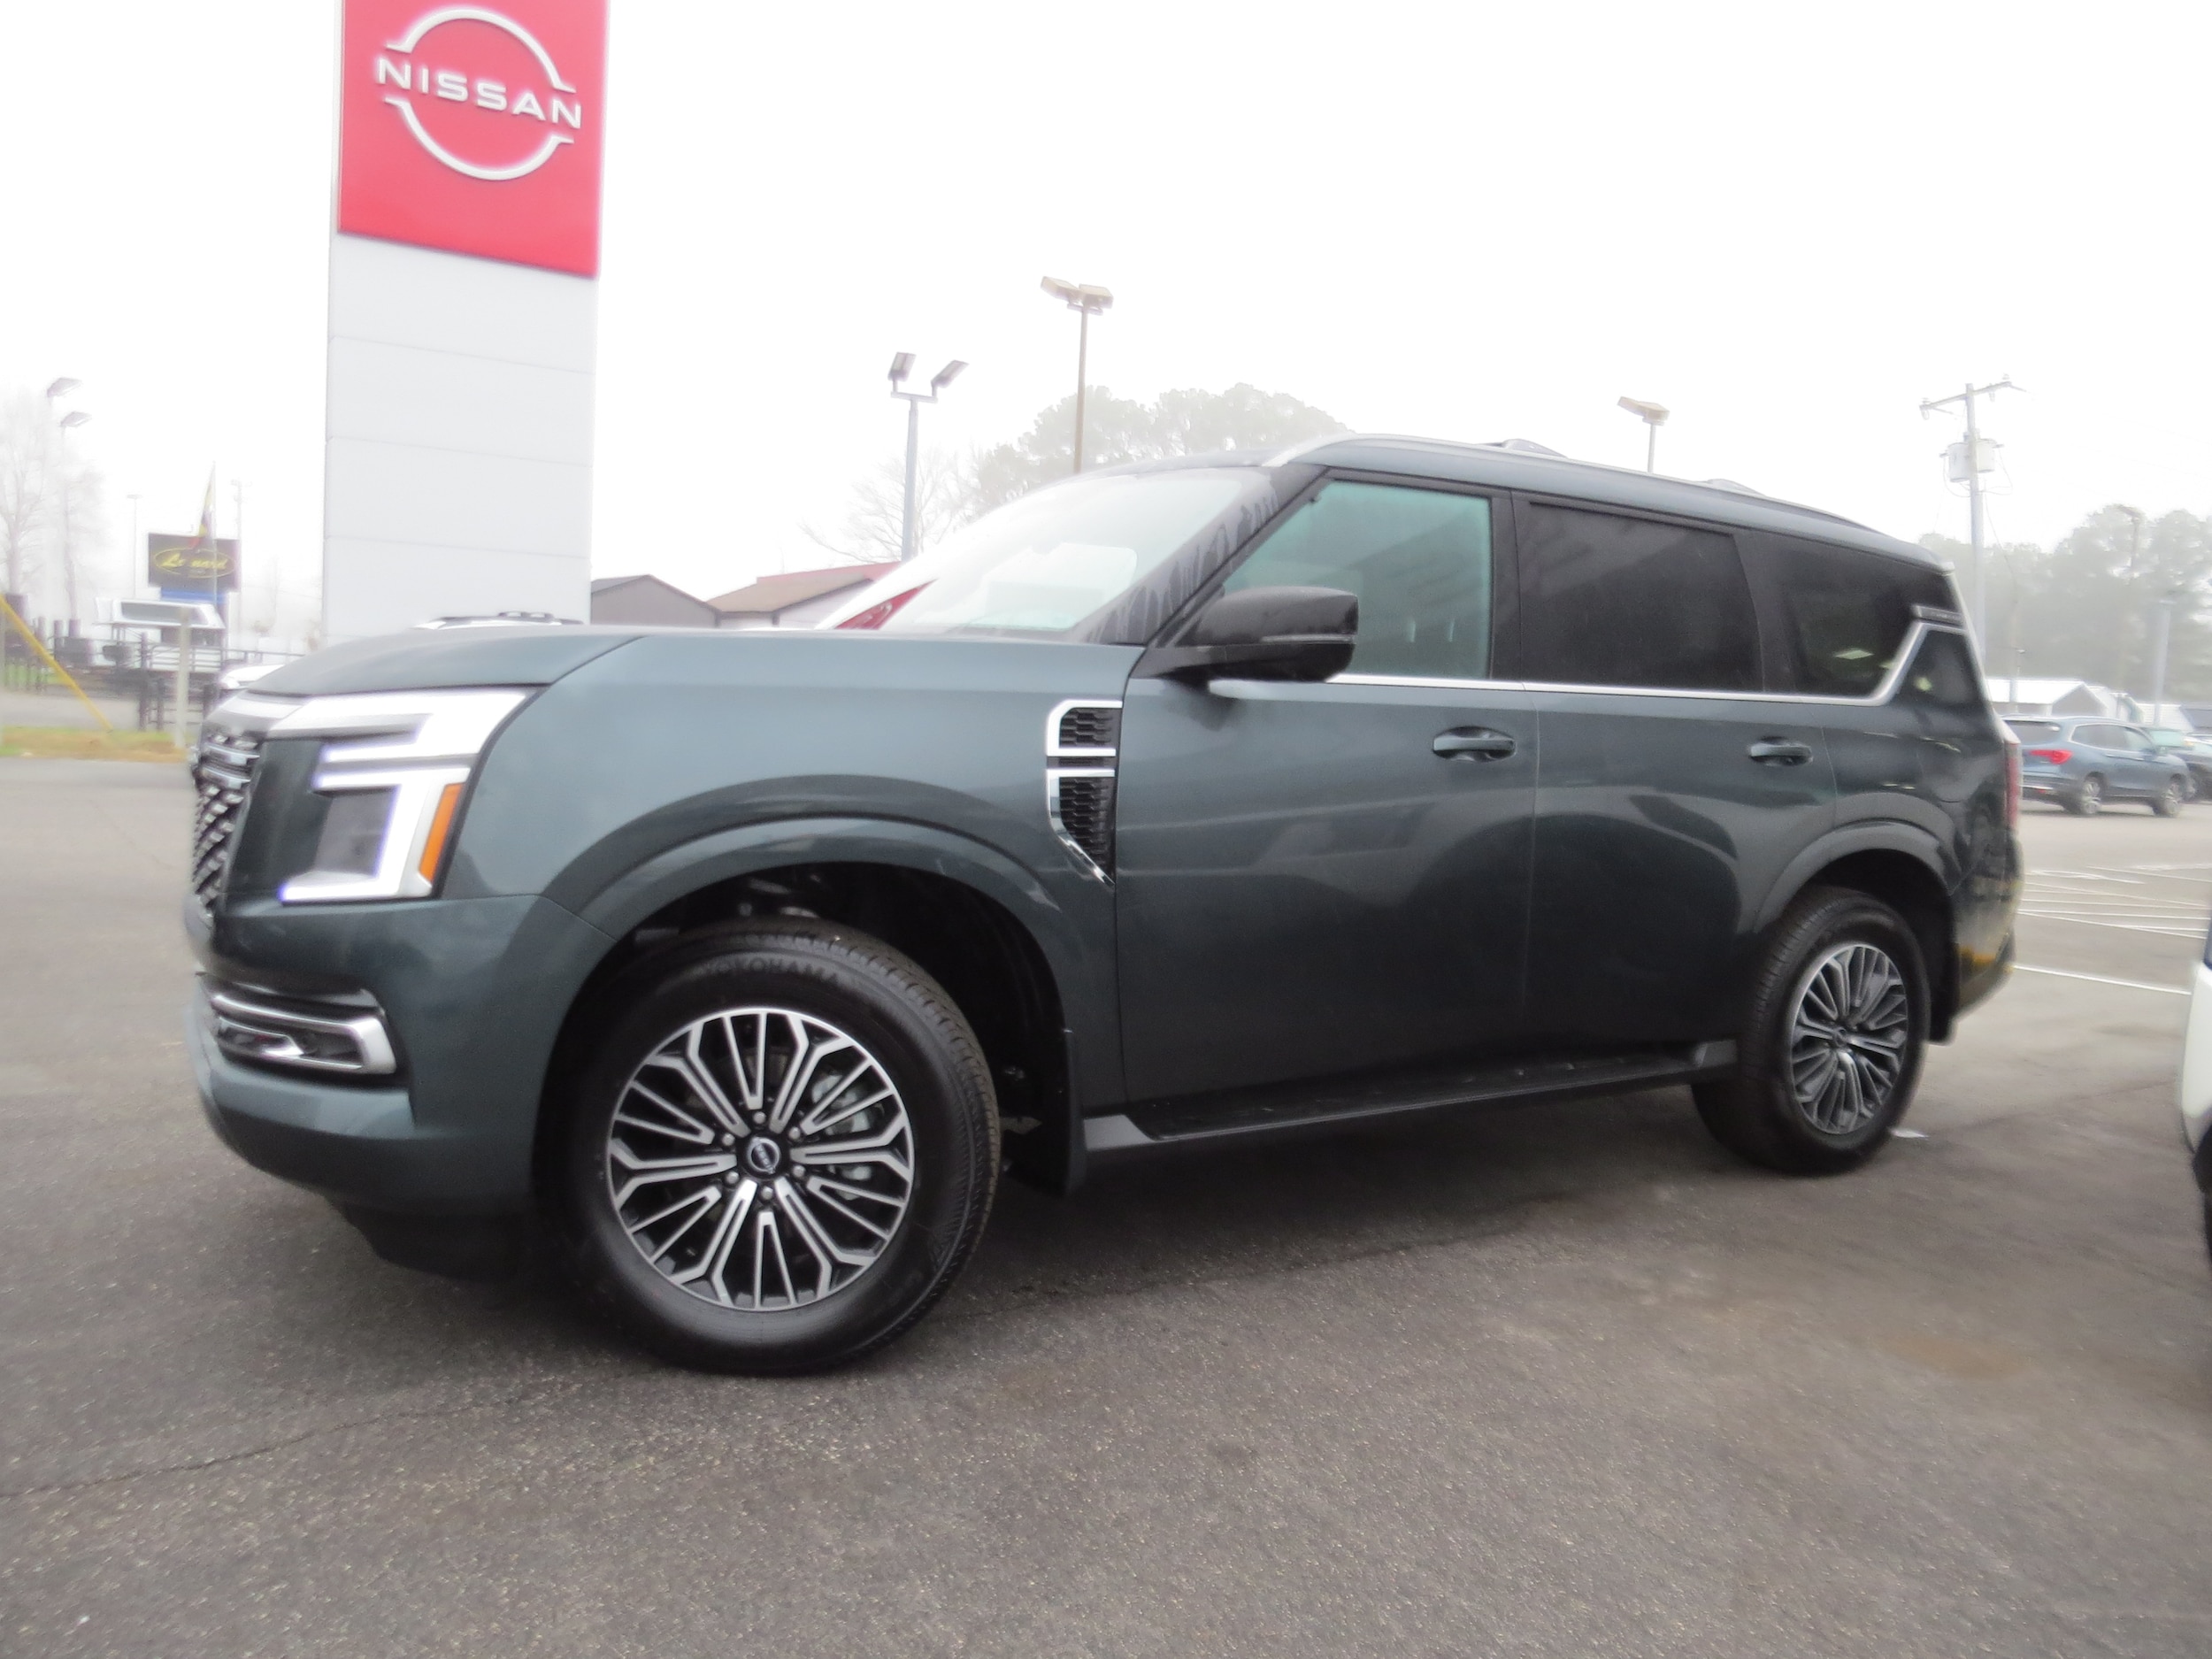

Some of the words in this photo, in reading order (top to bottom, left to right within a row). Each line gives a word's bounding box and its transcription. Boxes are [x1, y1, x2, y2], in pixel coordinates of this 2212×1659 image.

[377, 57, 582, 129] NISSAN
[160, 552, 228, 570] Lenard
[704, 956, 841, 985] OKOHAMA
